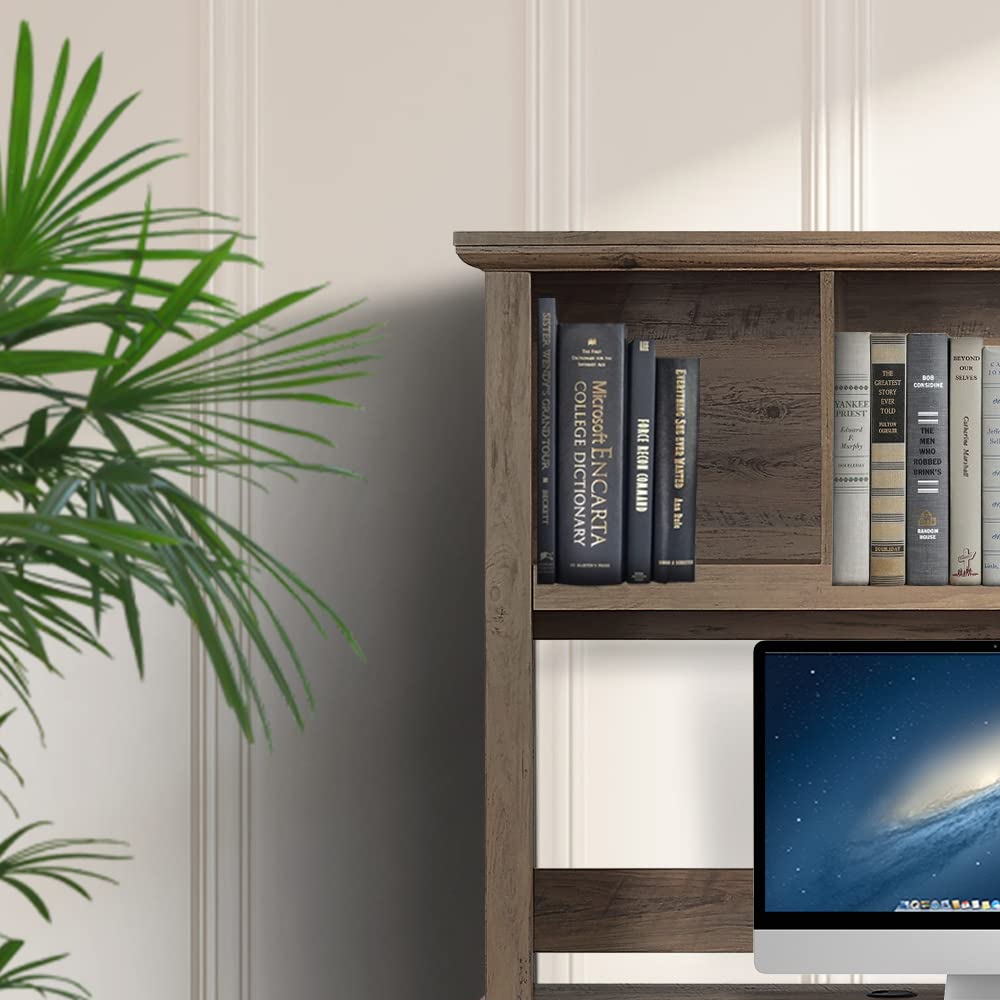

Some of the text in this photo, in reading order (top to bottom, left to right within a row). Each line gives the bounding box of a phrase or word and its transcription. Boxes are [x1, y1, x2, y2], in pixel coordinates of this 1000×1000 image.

[542, 312, 551, 346] SISTER
[542, 349, 551, 396] WENDY'S
[675, 368, 687, 417] EVERYTHING
[542, 398, 551, 438] GRAND
[591, 380, 608, 444] Microsoft
[834, 400, 869, 408] YANKEE
[541, 438, 551, 470] TOUR
[573, 381, 587, 547] COLLEGE DICTIONARY
[635, 418, 650, 513] FORCE RECON COMMAND
[675, 436, 685, 456] EVER
[841, 442, 863, 451] Murphy
[674, 457, 686, 489] WANTED
[591, 447, 613, 548] ENCARTA
